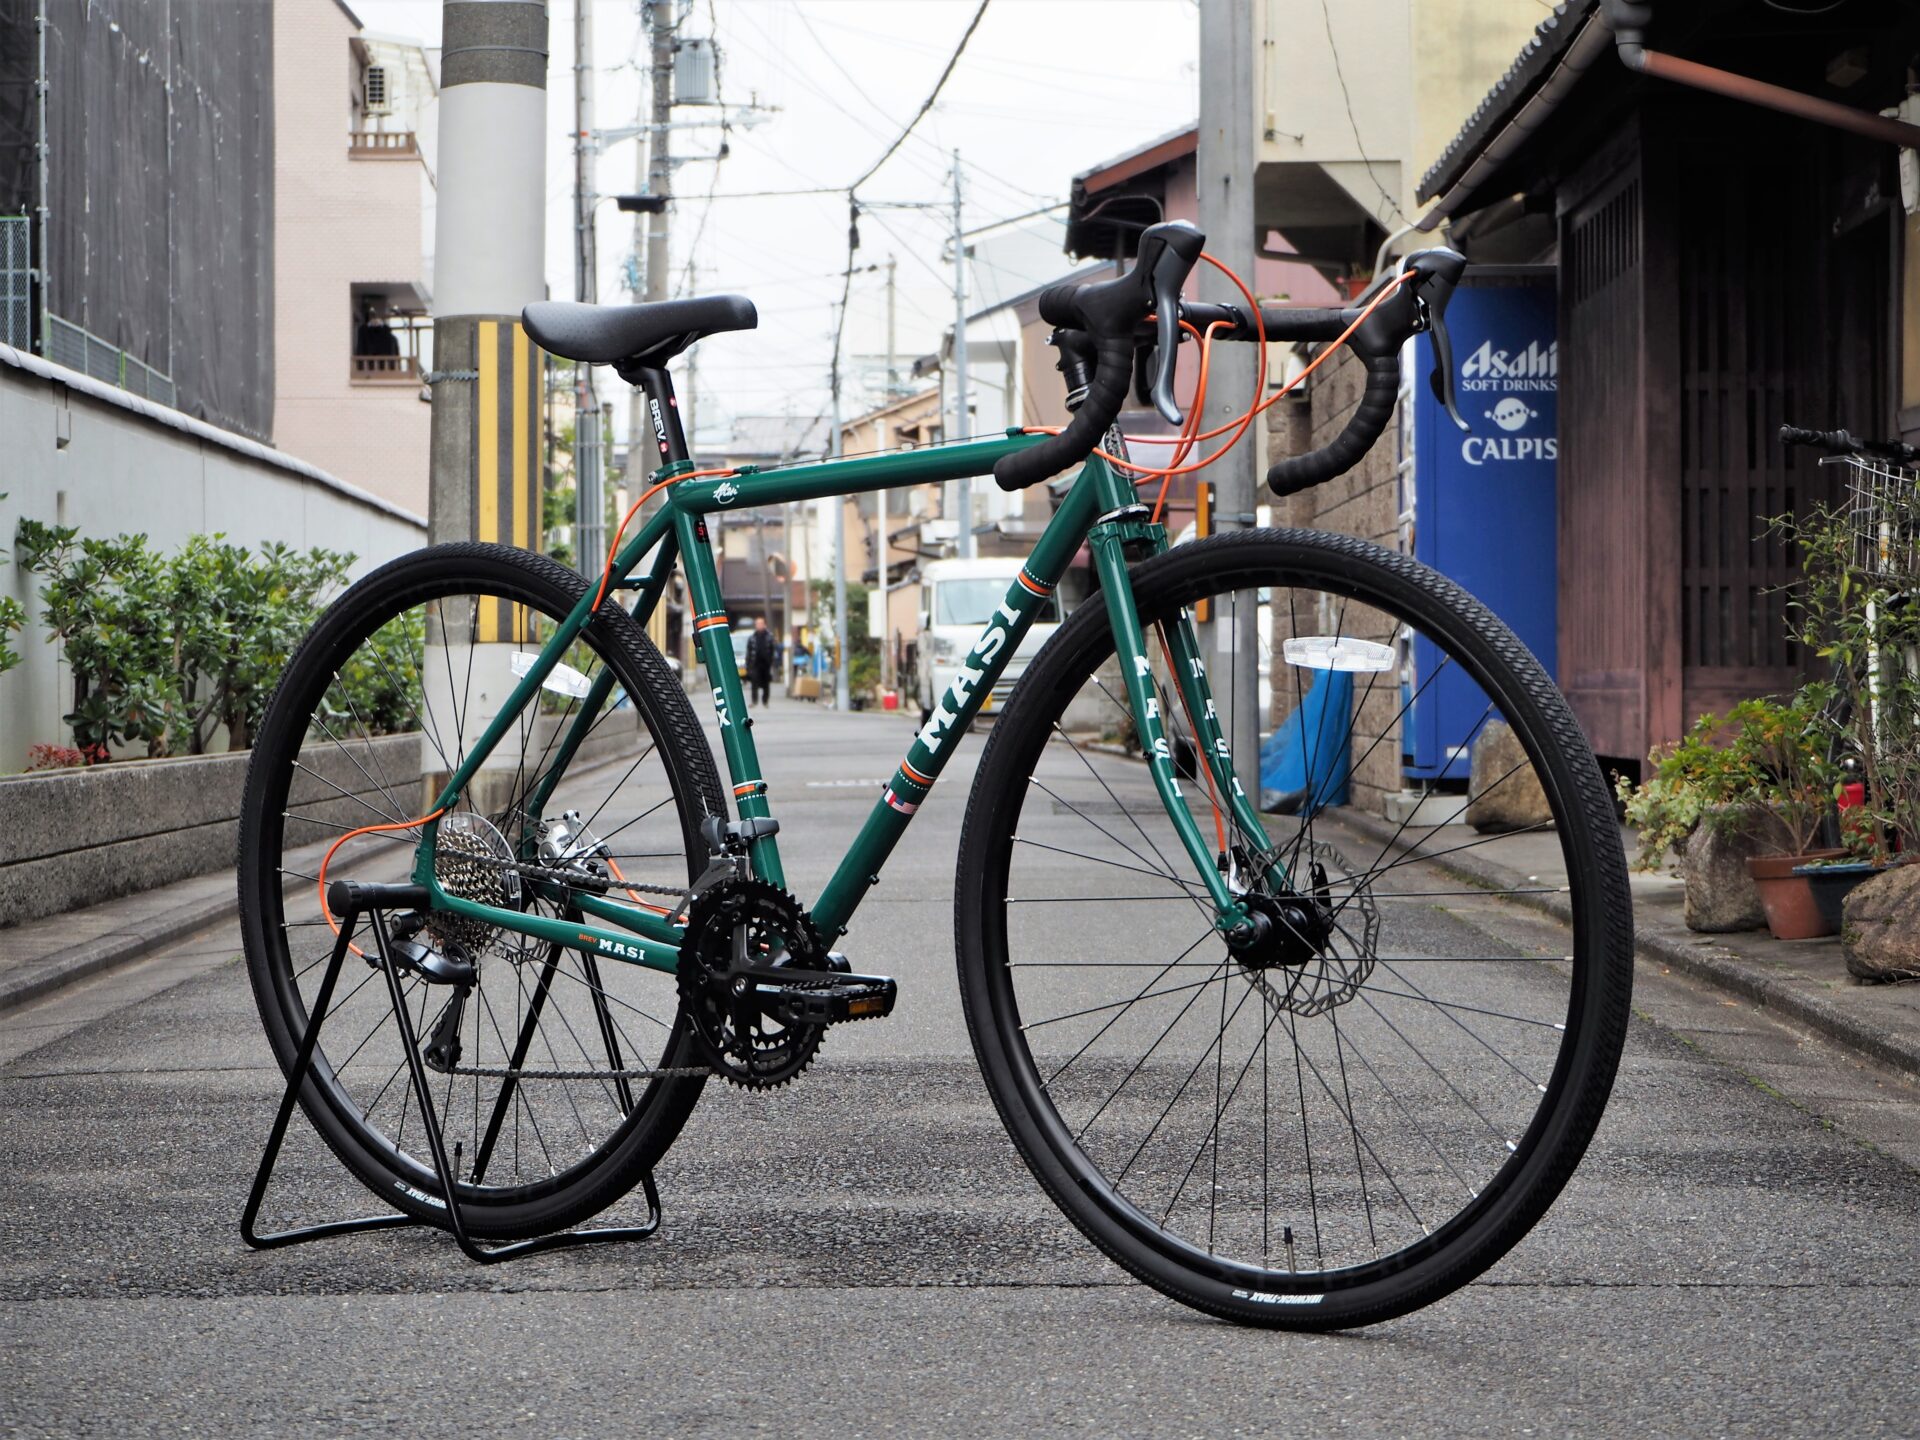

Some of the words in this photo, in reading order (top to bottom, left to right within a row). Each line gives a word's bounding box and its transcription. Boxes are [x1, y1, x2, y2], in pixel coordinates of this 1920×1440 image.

[1461, 340, 1558, 378] Asahi
[1462, 380, 1499, 391] SOFT
[1503, 380, 1557, 391] DRINKS
[1461, 437, 1558, 465] CALPIS
[917, 596, 1022, 754] MASI
[712, 686, 731, 728] CX
[1133, 655, 1184, 797] MASI
[1189, 657, 1245, 797] MASI
[598, 938, 646, 960] MASI
